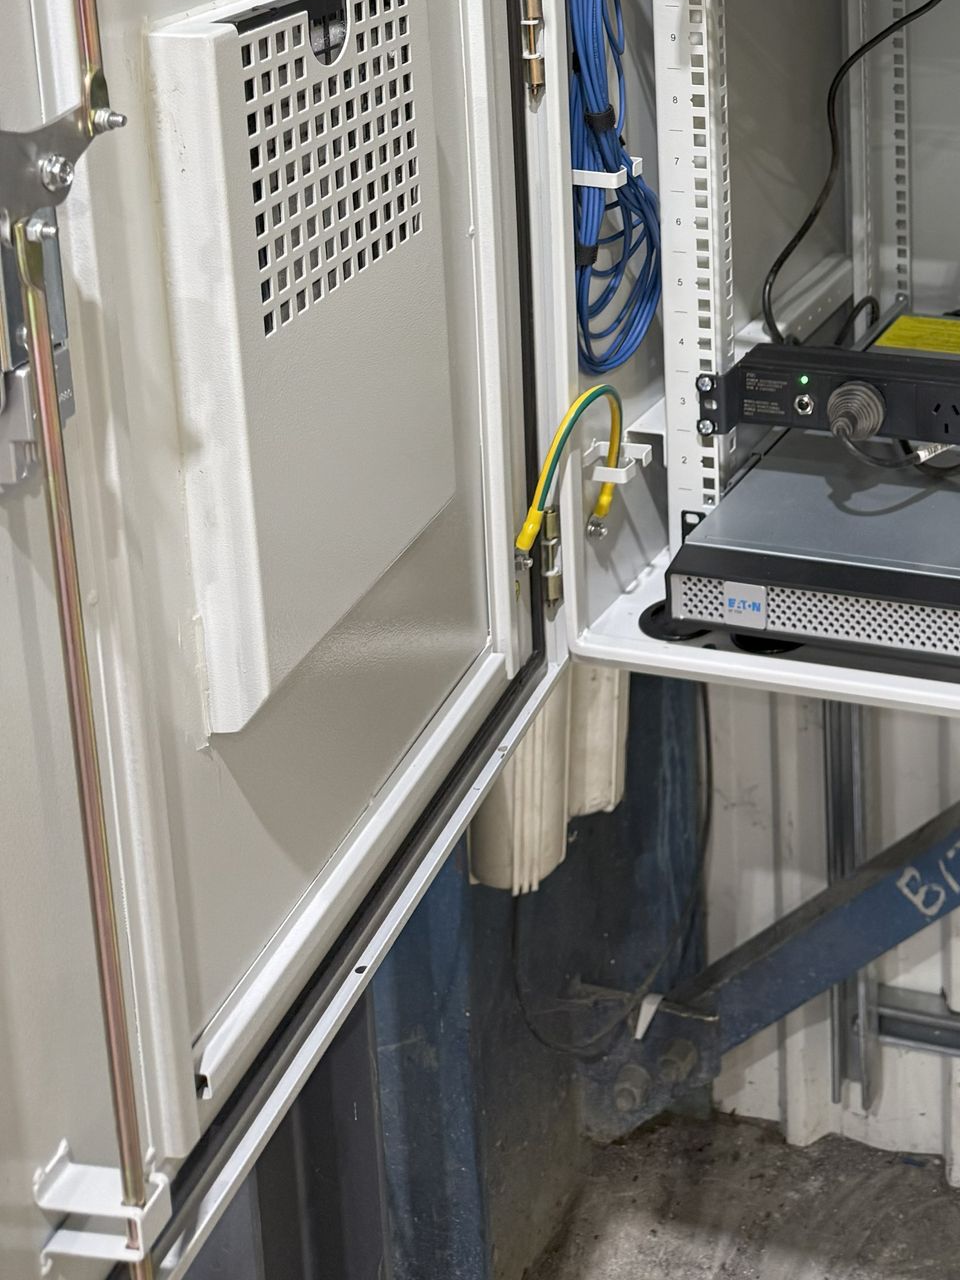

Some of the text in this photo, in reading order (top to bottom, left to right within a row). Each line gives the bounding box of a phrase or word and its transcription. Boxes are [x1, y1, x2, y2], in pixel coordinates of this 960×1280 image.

[670, 33, 677, 42] 9
[672, 95, 678, 104] 8
[674, 157, 680, 165] 7
[675, 218, 682, 226] 6
[677, 279, 683, 287] 5
[678, 338, 685, 346] 4
[680, 397, 686, 406] 3
[681, 456, 688, 465] 2
[728, 598, 761, 612] EATON
